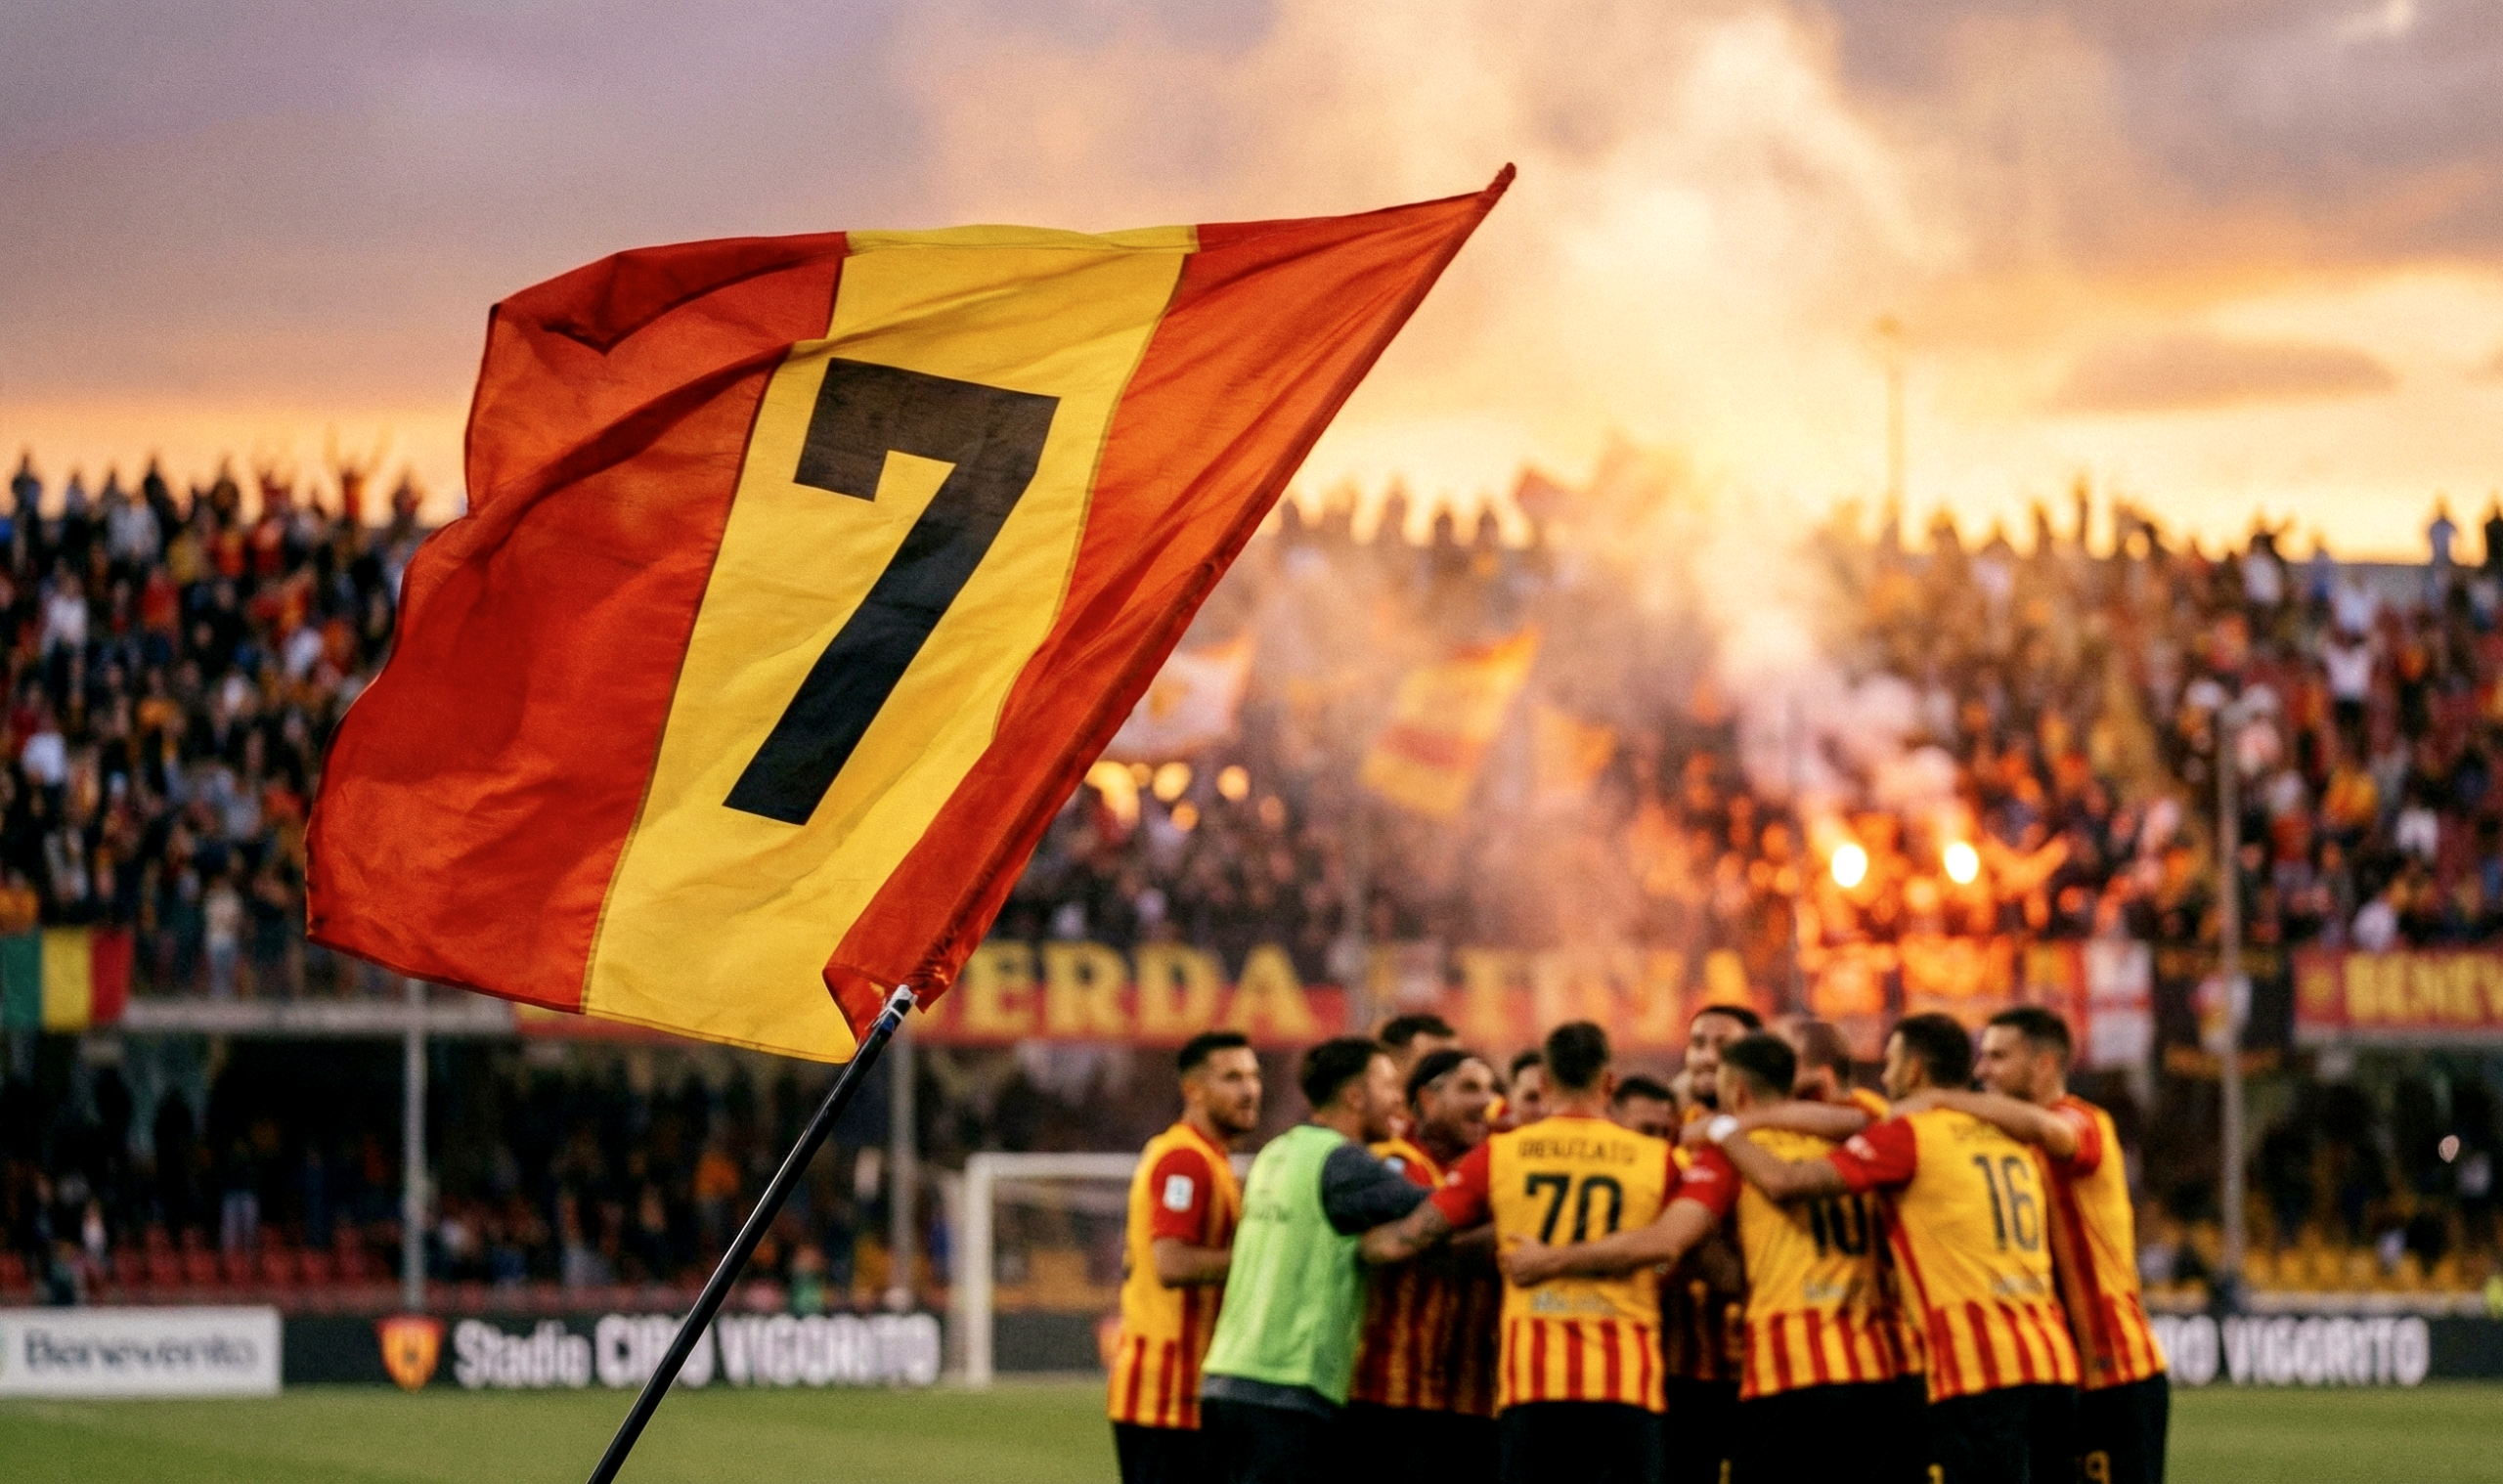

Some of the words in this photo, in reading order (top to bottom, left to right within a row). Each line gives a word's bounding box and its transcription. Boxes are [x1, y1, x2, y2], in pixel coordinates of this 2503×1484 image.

[722, 358, 1061, 825] 7
[919, 940, 1317, 1038] ERDA
[1525, 1173, 1623, 1245] 70
[1972, 1154, 2040, 1251] 16
[453, 1319, 592, 1388] Stadio
